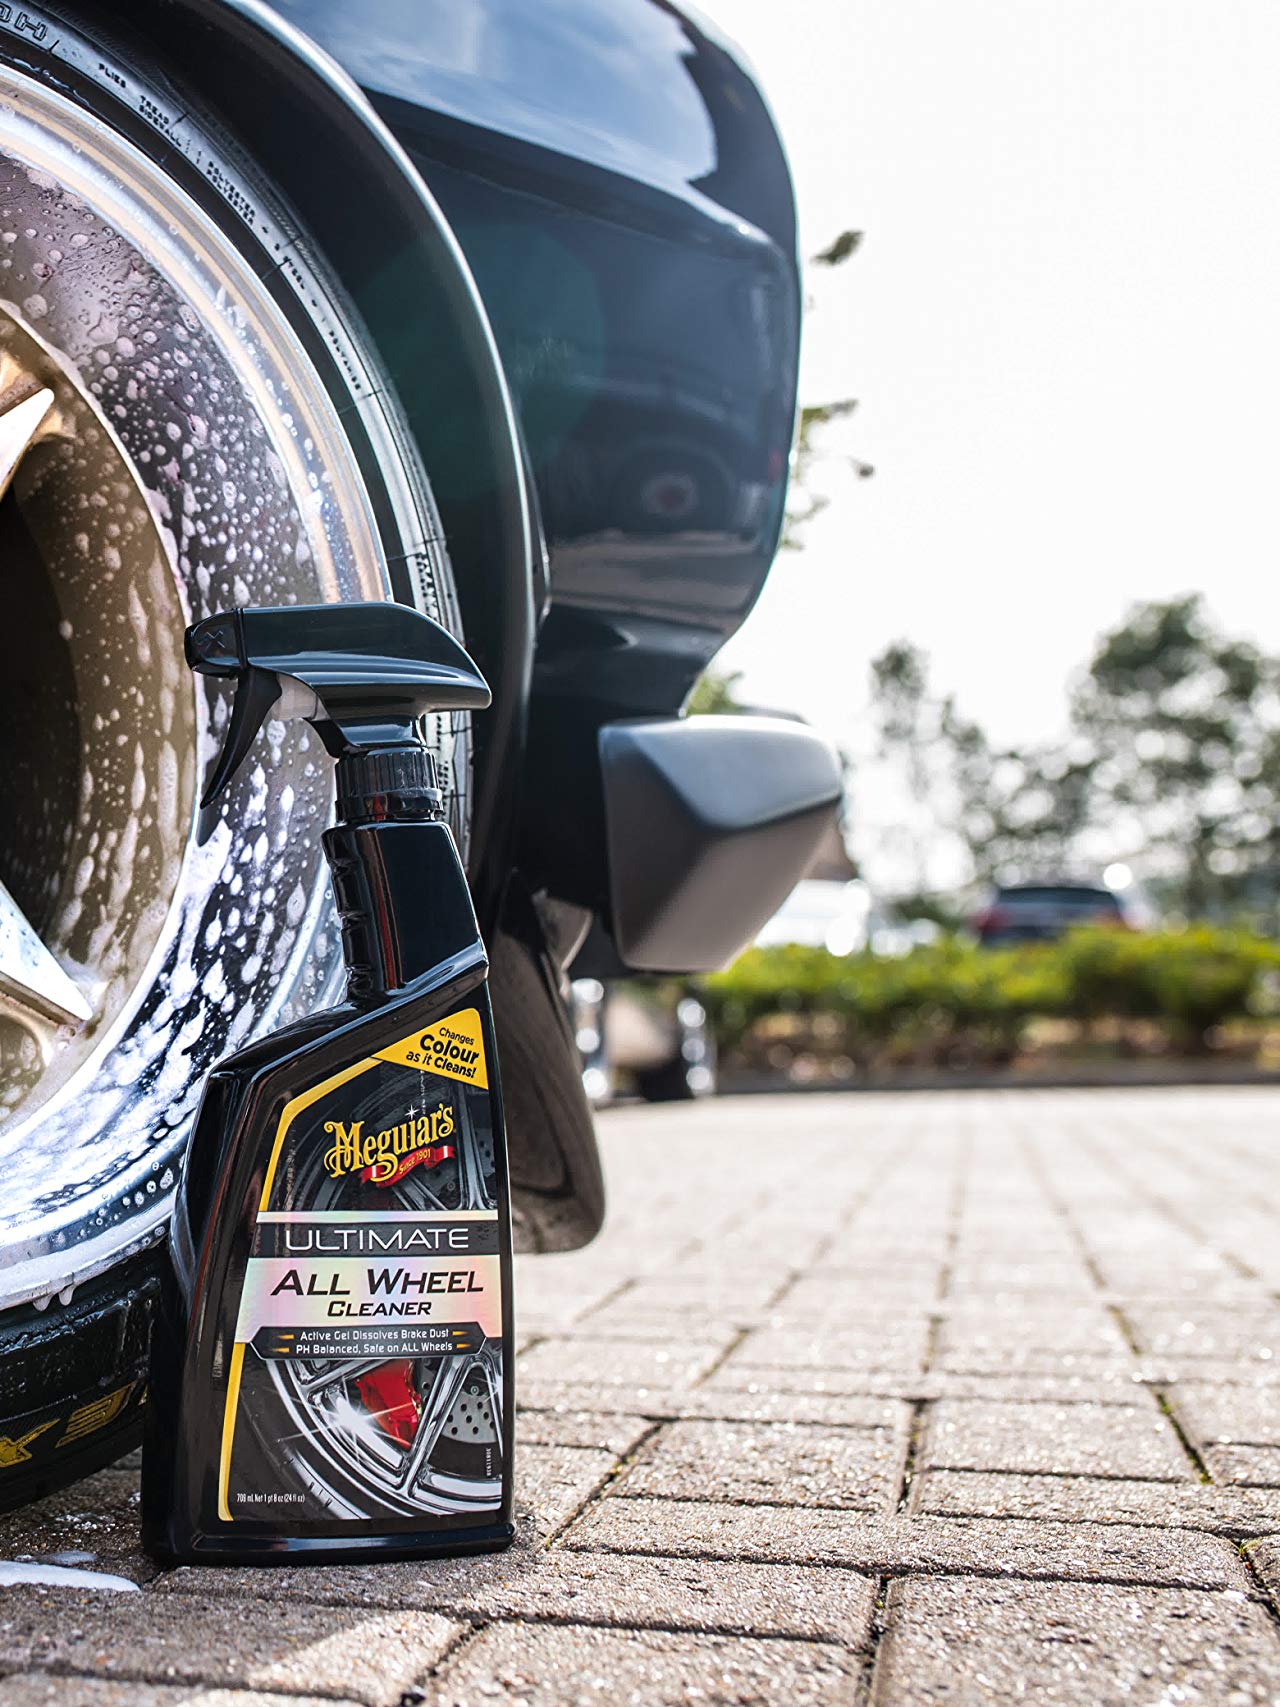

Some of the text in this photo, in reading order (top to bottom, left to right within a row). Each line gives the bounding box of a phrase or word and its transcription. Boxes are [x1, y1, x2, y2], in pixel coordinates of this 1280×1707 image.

[98, 63, 126, 88] PLIES
[140, 95, 169, 124] TREAD
[208, 161, 256, 217] POLYESTER
[206, 169, 254, 225] POLYESTER
[420, 1034, 480, 1065] Colour
[439, 1027, 475, 1046] Changes
[406, 1051, 477, 1078] as it Cleans!
[323, 1103, 454, 1182] Meguiar's
[285, 1227, 469, 1251] ULTIMATE
[270, 1268, 484, 1296] ALL WHEEL
[327, 1301, 432, 1317] CLEANER
[296, 1345, 310, 1354] PH
[313, 1344, 362, 1354] Balanced,
[363, 1343, 385, 1353] Safe
[401, 1342, 419, 1352] ALL
[421, 1341, 453, 1351] Wheels
[300, 1328, 449, 1341] Active Gel Dissolves Brake Dust
